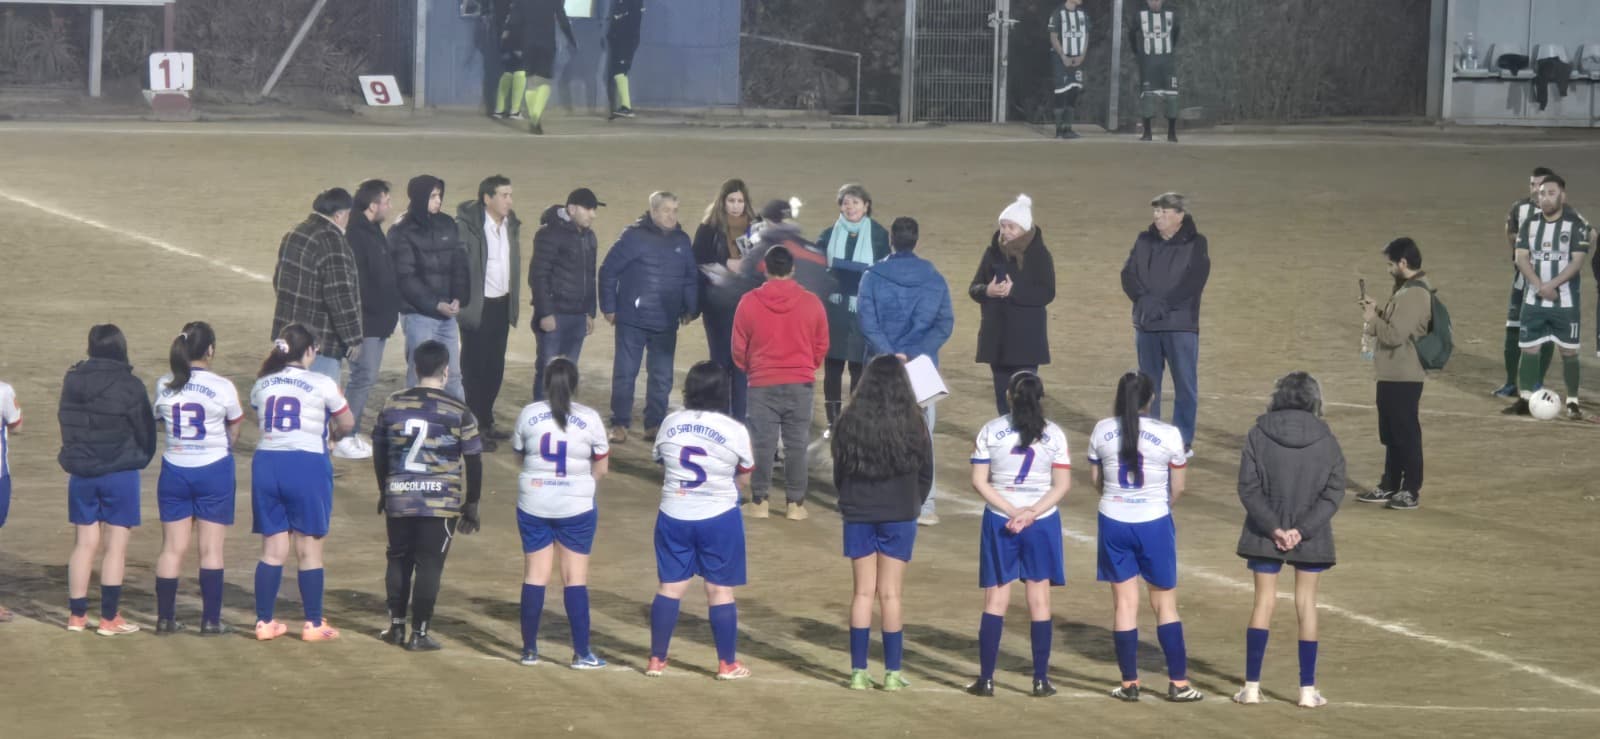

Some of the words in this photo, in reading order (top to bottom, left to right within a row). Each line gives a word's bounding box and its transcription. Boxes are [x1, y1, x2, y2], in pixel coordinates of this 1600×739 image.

[159, 59, 170, 88] 1
[370, 81, 391, 104] 9
[172, 402, 206, 441] 13
[264, 395, 301, 433] 18
[528, 415, 538, 426] CD
[405, 418, 428, 472] 2
[667, 427, 676, 438] CD
[677, 424, 692, 434] SAN
[693, 424, 726, 444] ANTONIO
[540, 432, 567, 478] 4
[679, 446, 708, 489] 5
[1010, 446, 1035, 485] 7
[389, 481, 442, 492] CHOCOLATES
